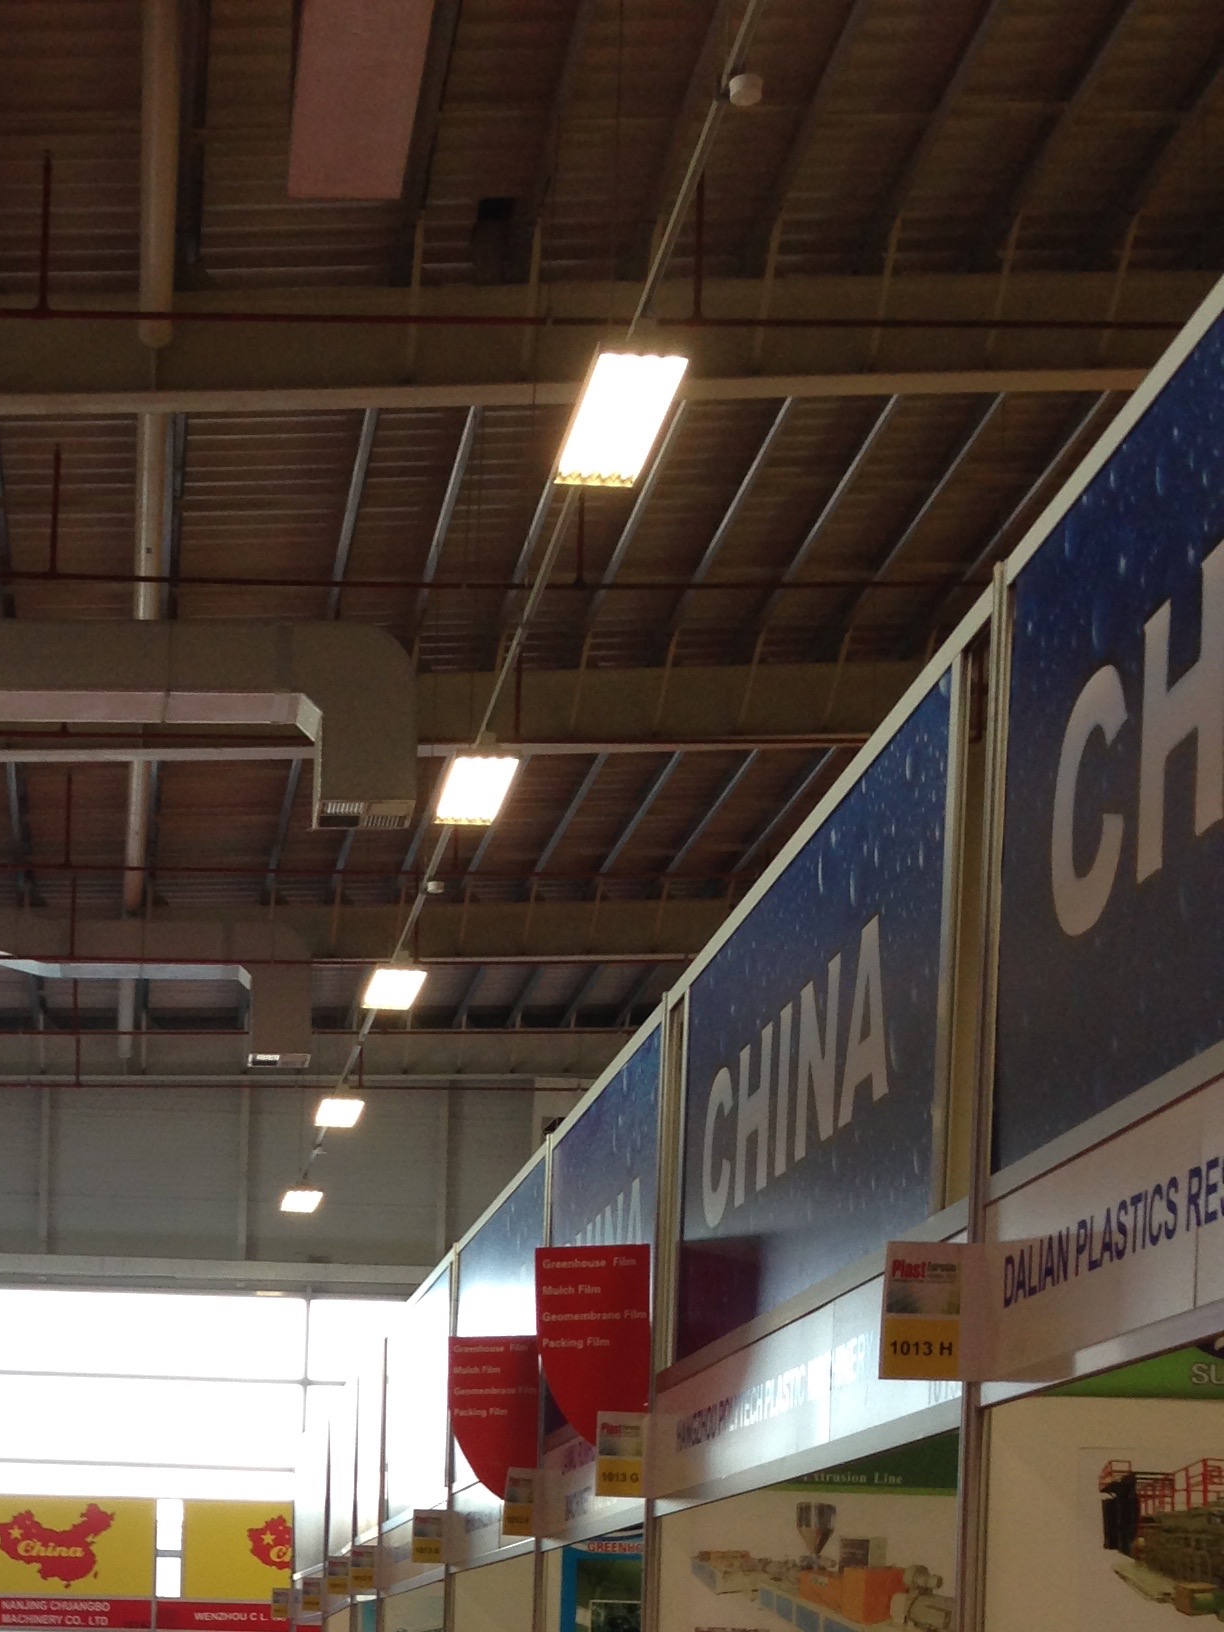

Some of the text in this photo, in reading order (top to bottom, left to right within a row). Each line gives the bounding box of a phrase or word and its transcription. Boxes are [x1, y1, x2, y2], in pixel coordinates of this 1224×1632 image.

[703, 915, 889, 1229] CHINA
[1004, 1226, 1070, 1308] DALIAN
[1075, 1176, 1179, 1278] PLASTICS
[542, 1256, 637, 1269] Greenhouse Film
[892, 1260, 927, 1279] Plast
[542, 1284, 601, 1296] Mulch Film
[542, 1309, 647, 1322] Geomembrane Film
[542, 1336, 610, 1349] Packing Film
[891, 1341, 953, 1356] 1013 H
[601, 1471, 627, 1482] 1013
[874, 1472, 904, 1485] Line
[17, 1538, 85, 1558] China
[1, 1600, 111, 1612] NANJING CHUANGBO
[1, 1613, 63, 1624] MACHINERY
[194, 1612, 247, 1621] WENZHOU
